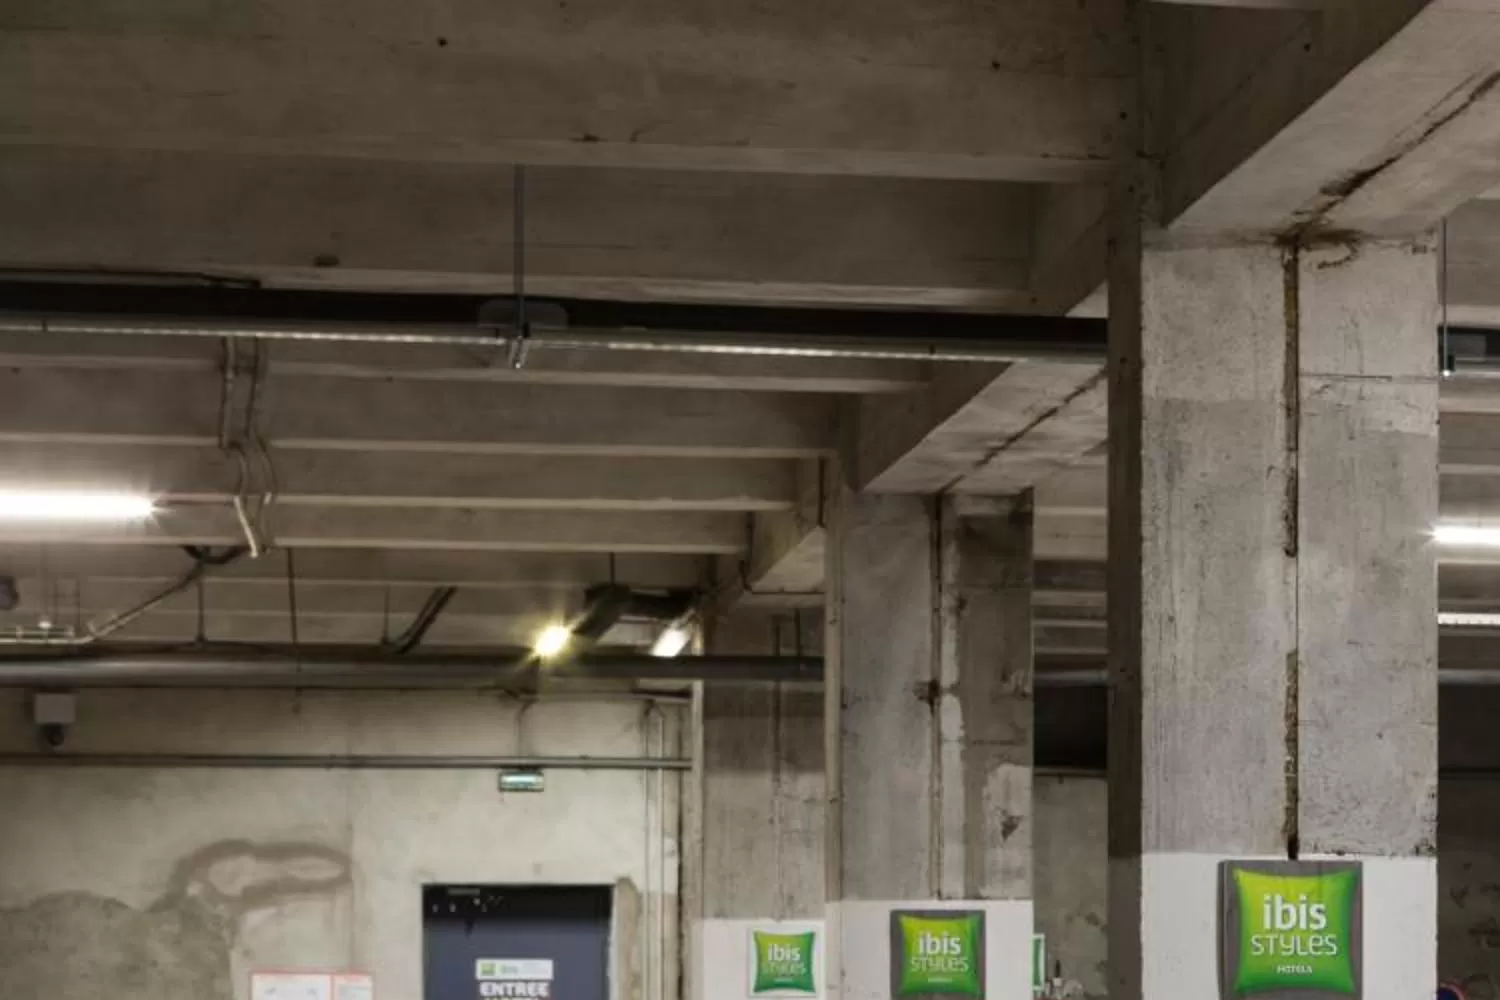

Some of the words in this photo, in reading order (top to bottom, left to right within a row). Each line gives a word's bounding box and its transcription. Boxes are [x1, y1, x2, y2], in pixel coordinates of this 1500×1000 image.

[1263, 893, 1327, 930] ibis
[767, 943, 801, 961] ibis
[918, 931, 962, 955] ibis
